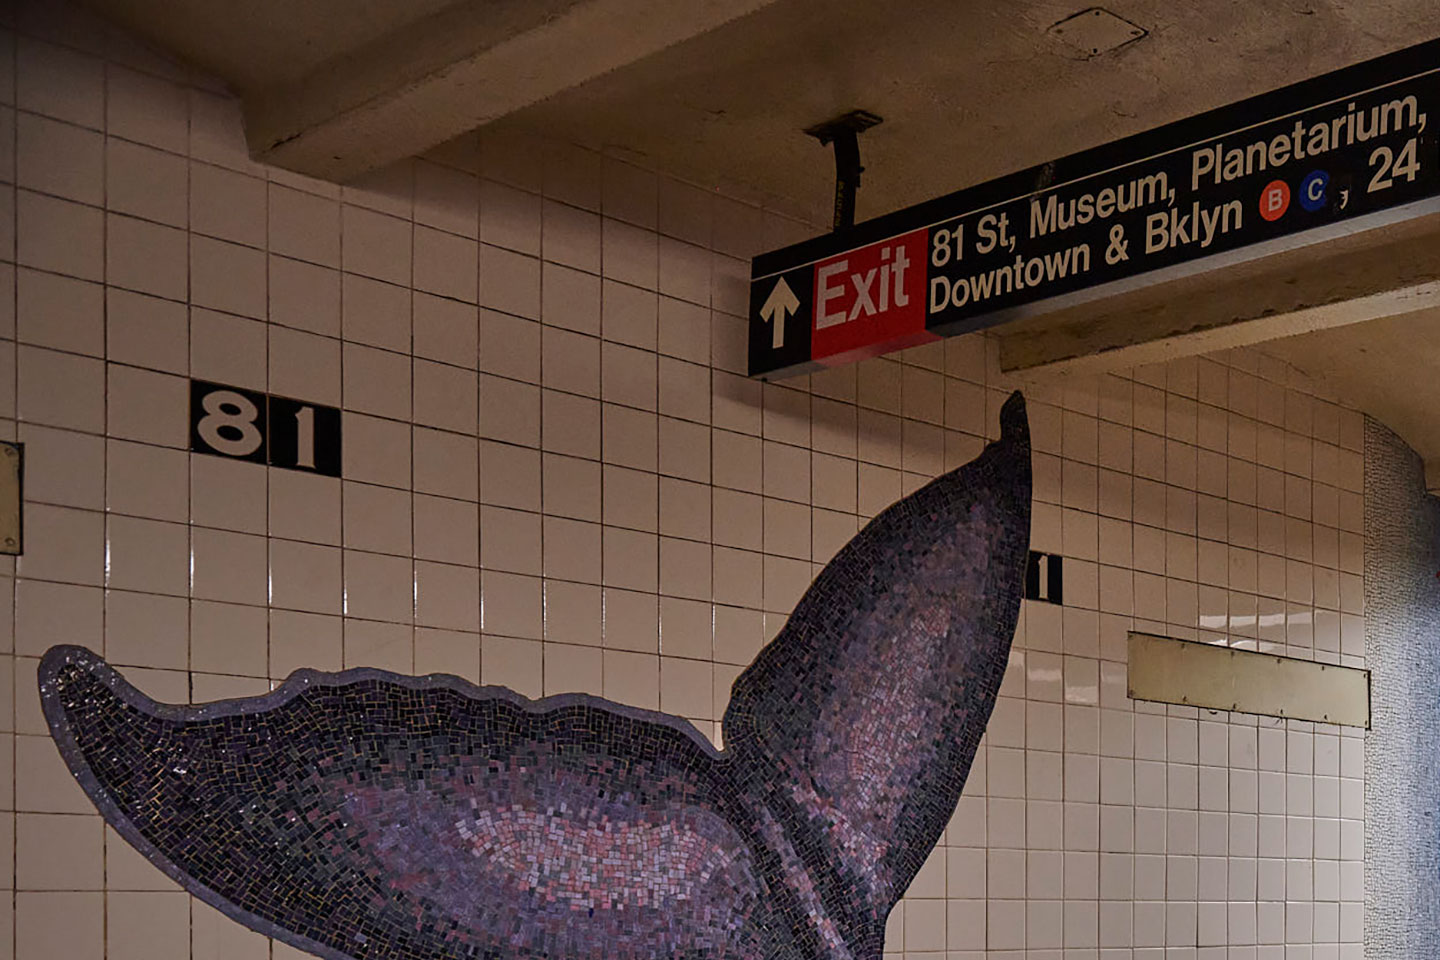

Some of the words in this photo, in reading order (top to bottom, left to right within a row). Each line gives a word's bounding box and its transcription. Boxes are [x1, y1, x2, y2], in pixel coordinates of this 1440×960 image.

[930, 244, 1090, 314] Downtown
[1105, 224, 1130, 265] &
[1146, 199, 1242, 254] Bklyn
[1367, 146, 1421, 193] 24
[932, 224, 964, 268] 81
[977, 213, 1016, 254] St,
[1030, 171, 1175, 240] Museum,
[1192, 95, 1427, 190] Planetarium,
[815, 245, 910, 331] Exit
[197, 390, 317, 469] 81
